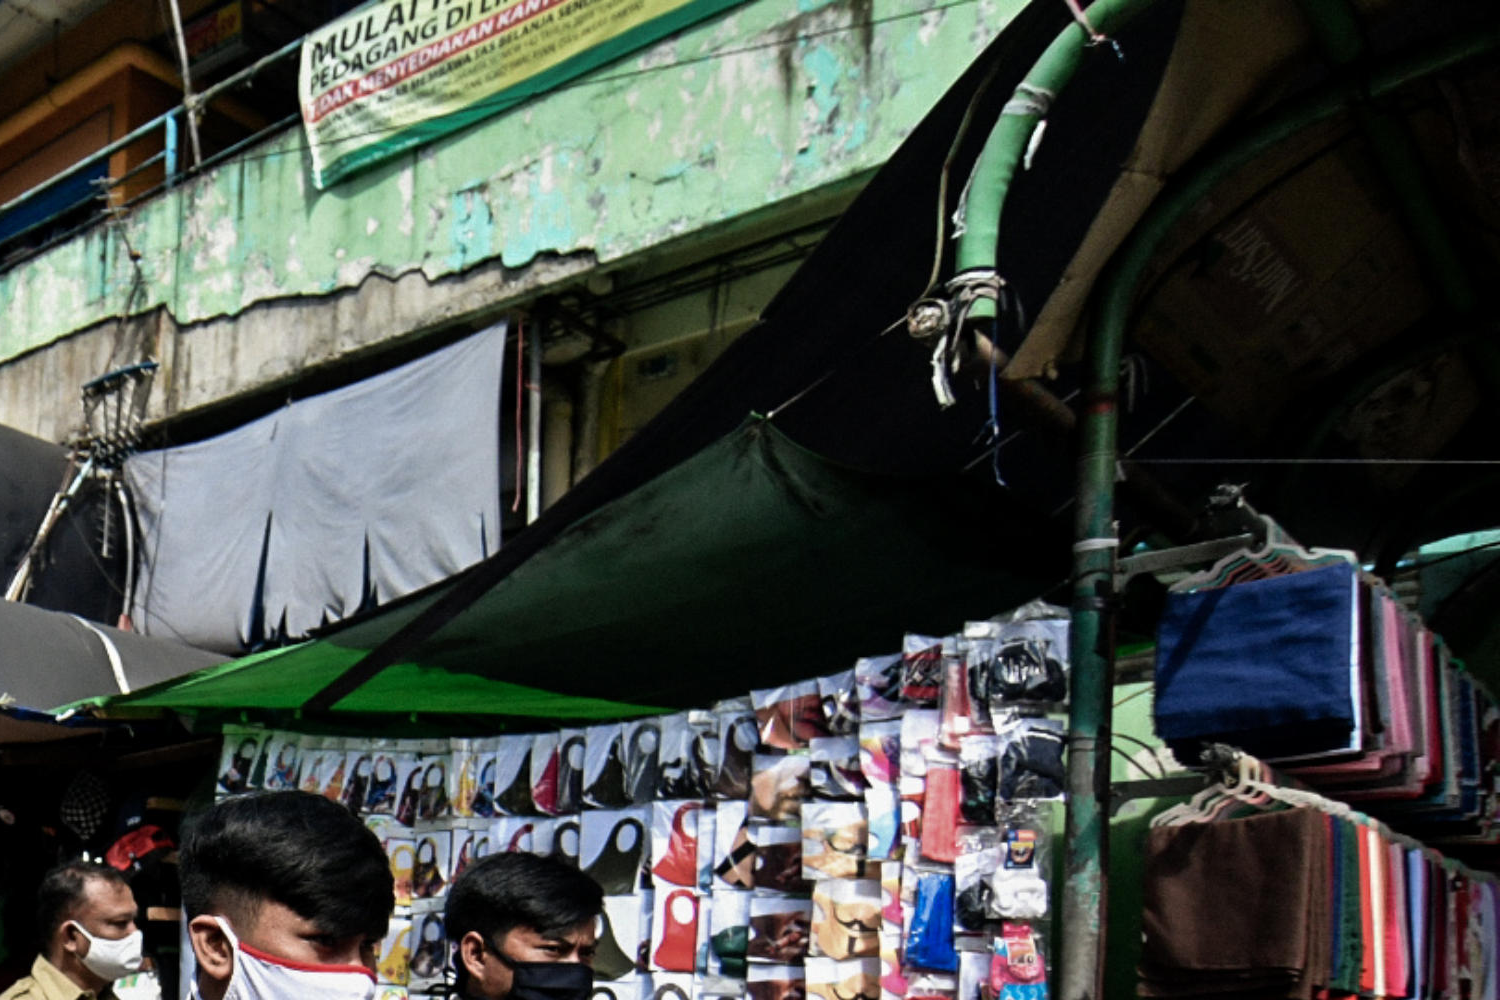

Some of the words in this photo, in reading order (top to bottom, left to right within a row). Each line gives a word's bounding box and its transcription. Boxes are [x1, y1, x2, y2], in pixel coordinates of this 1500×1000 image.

[310, 17, 438, 95] PEDAGANG
[446, 1, 473, 30] DI
[311, 0, 418, 69] MULAI
[358, 18, 494, 93] MENYEDIAKAN
[496, 0, 562, 28] KANT
